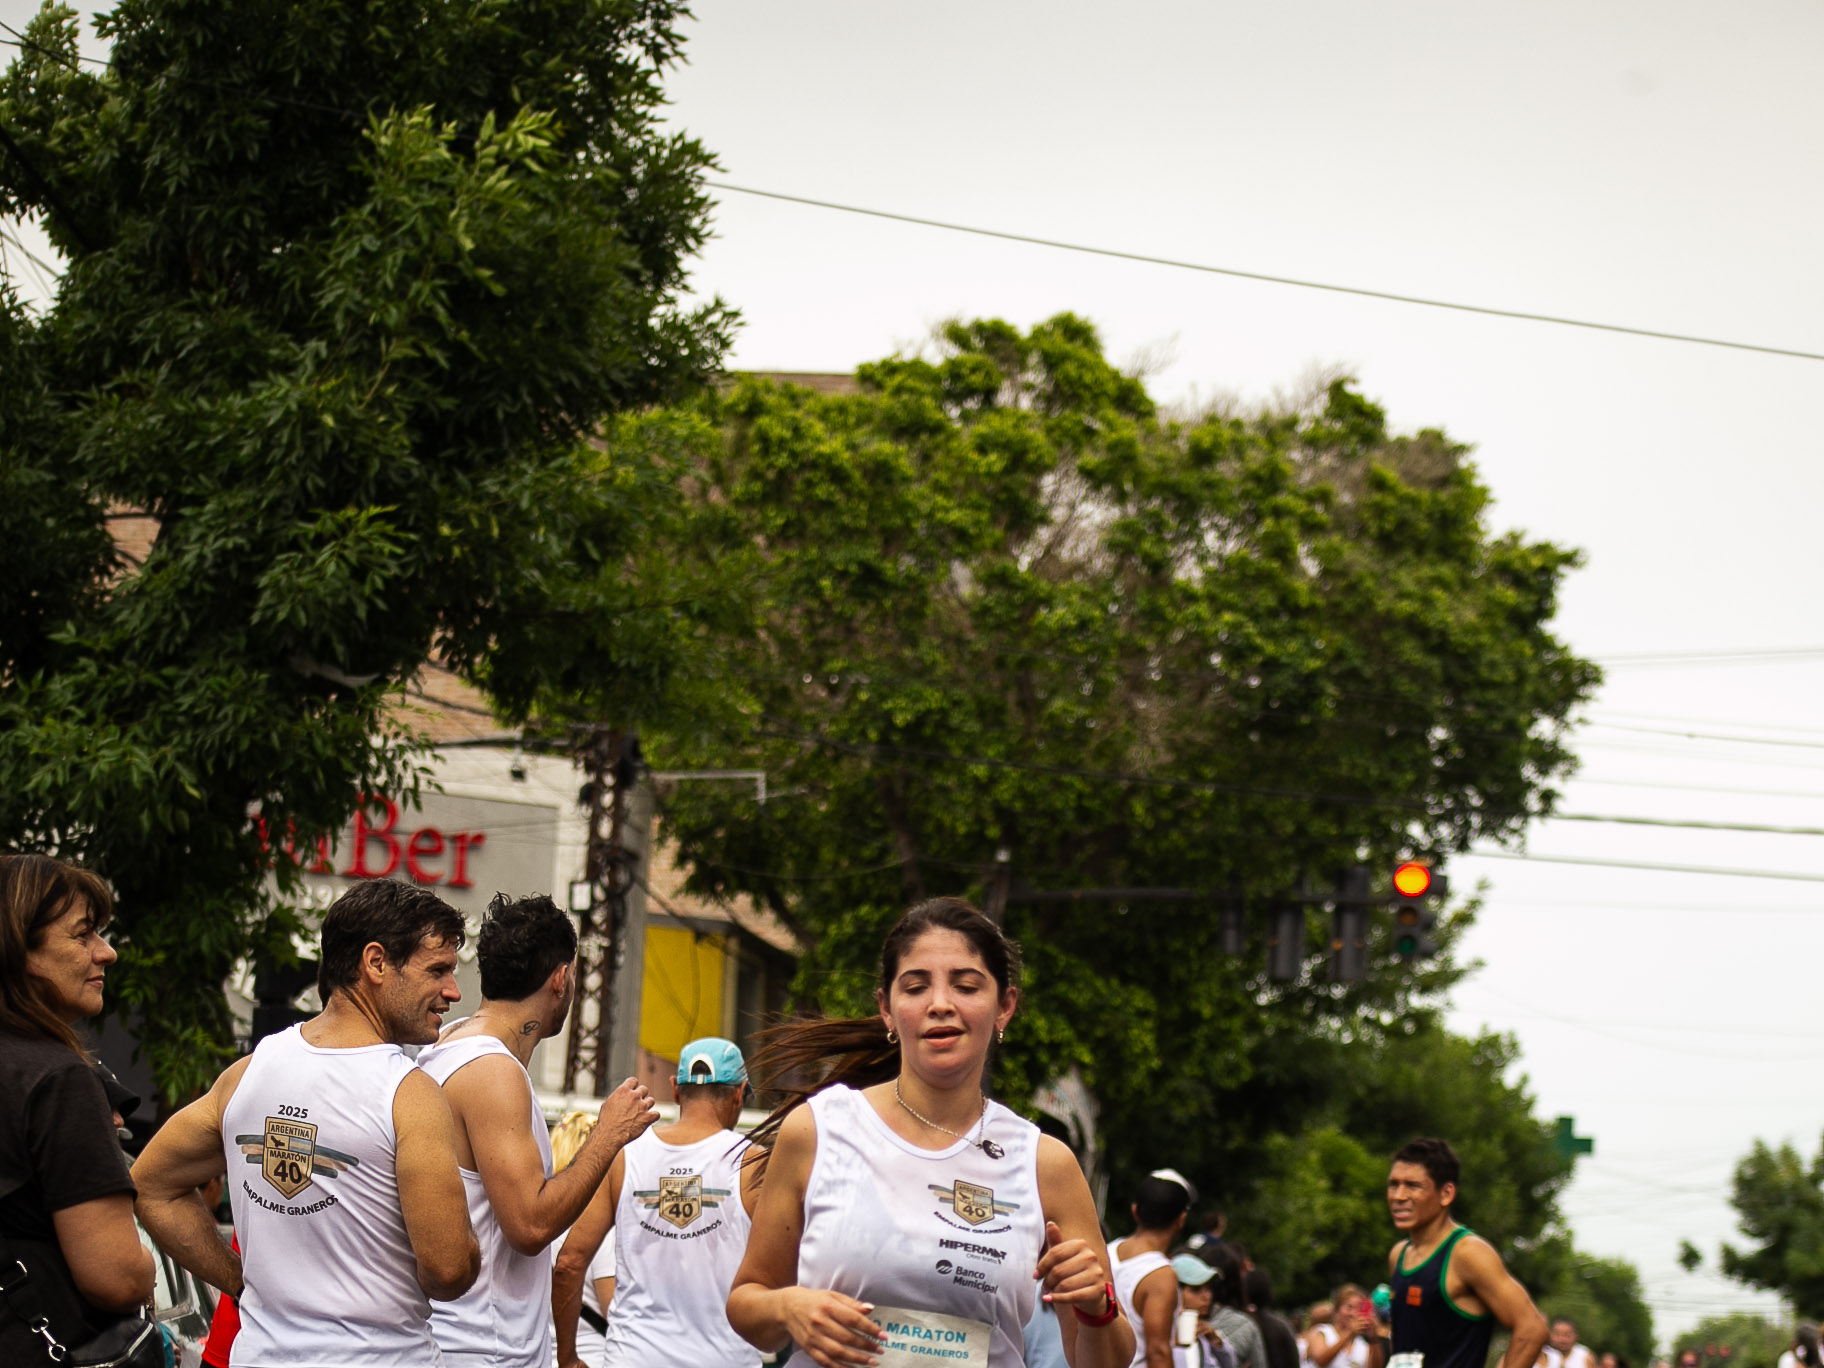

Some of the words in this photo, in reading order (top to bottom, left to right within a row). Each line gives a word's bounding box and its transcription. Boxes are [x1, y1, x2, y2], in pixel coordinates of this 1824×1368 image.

[277, 1104, 309, 1119] 2025
[270, 1124, 310, 1139] ARGENTINA
[269, 1150, 307, 1164] MARATÓN
[273, 1160, 303, 1184] 40
[669, 1167, 694, 1175] 2025
[242, 1180, 286, 1214] EMPALME
[668, 1202, 694, 1218] 40
[963, 1204, 986, 1218] 40
[640, 1220, 679, 1240] EMPALME
[680, 1219, 722, 1240] GRANEROS
[955, 1265, 986, 1280] Banco
[953, 1276, 998, 1294] Municipal
[886, 1321, 967, 1344] MARATON
[910, 1344, 969, 1360] GRANEROS
